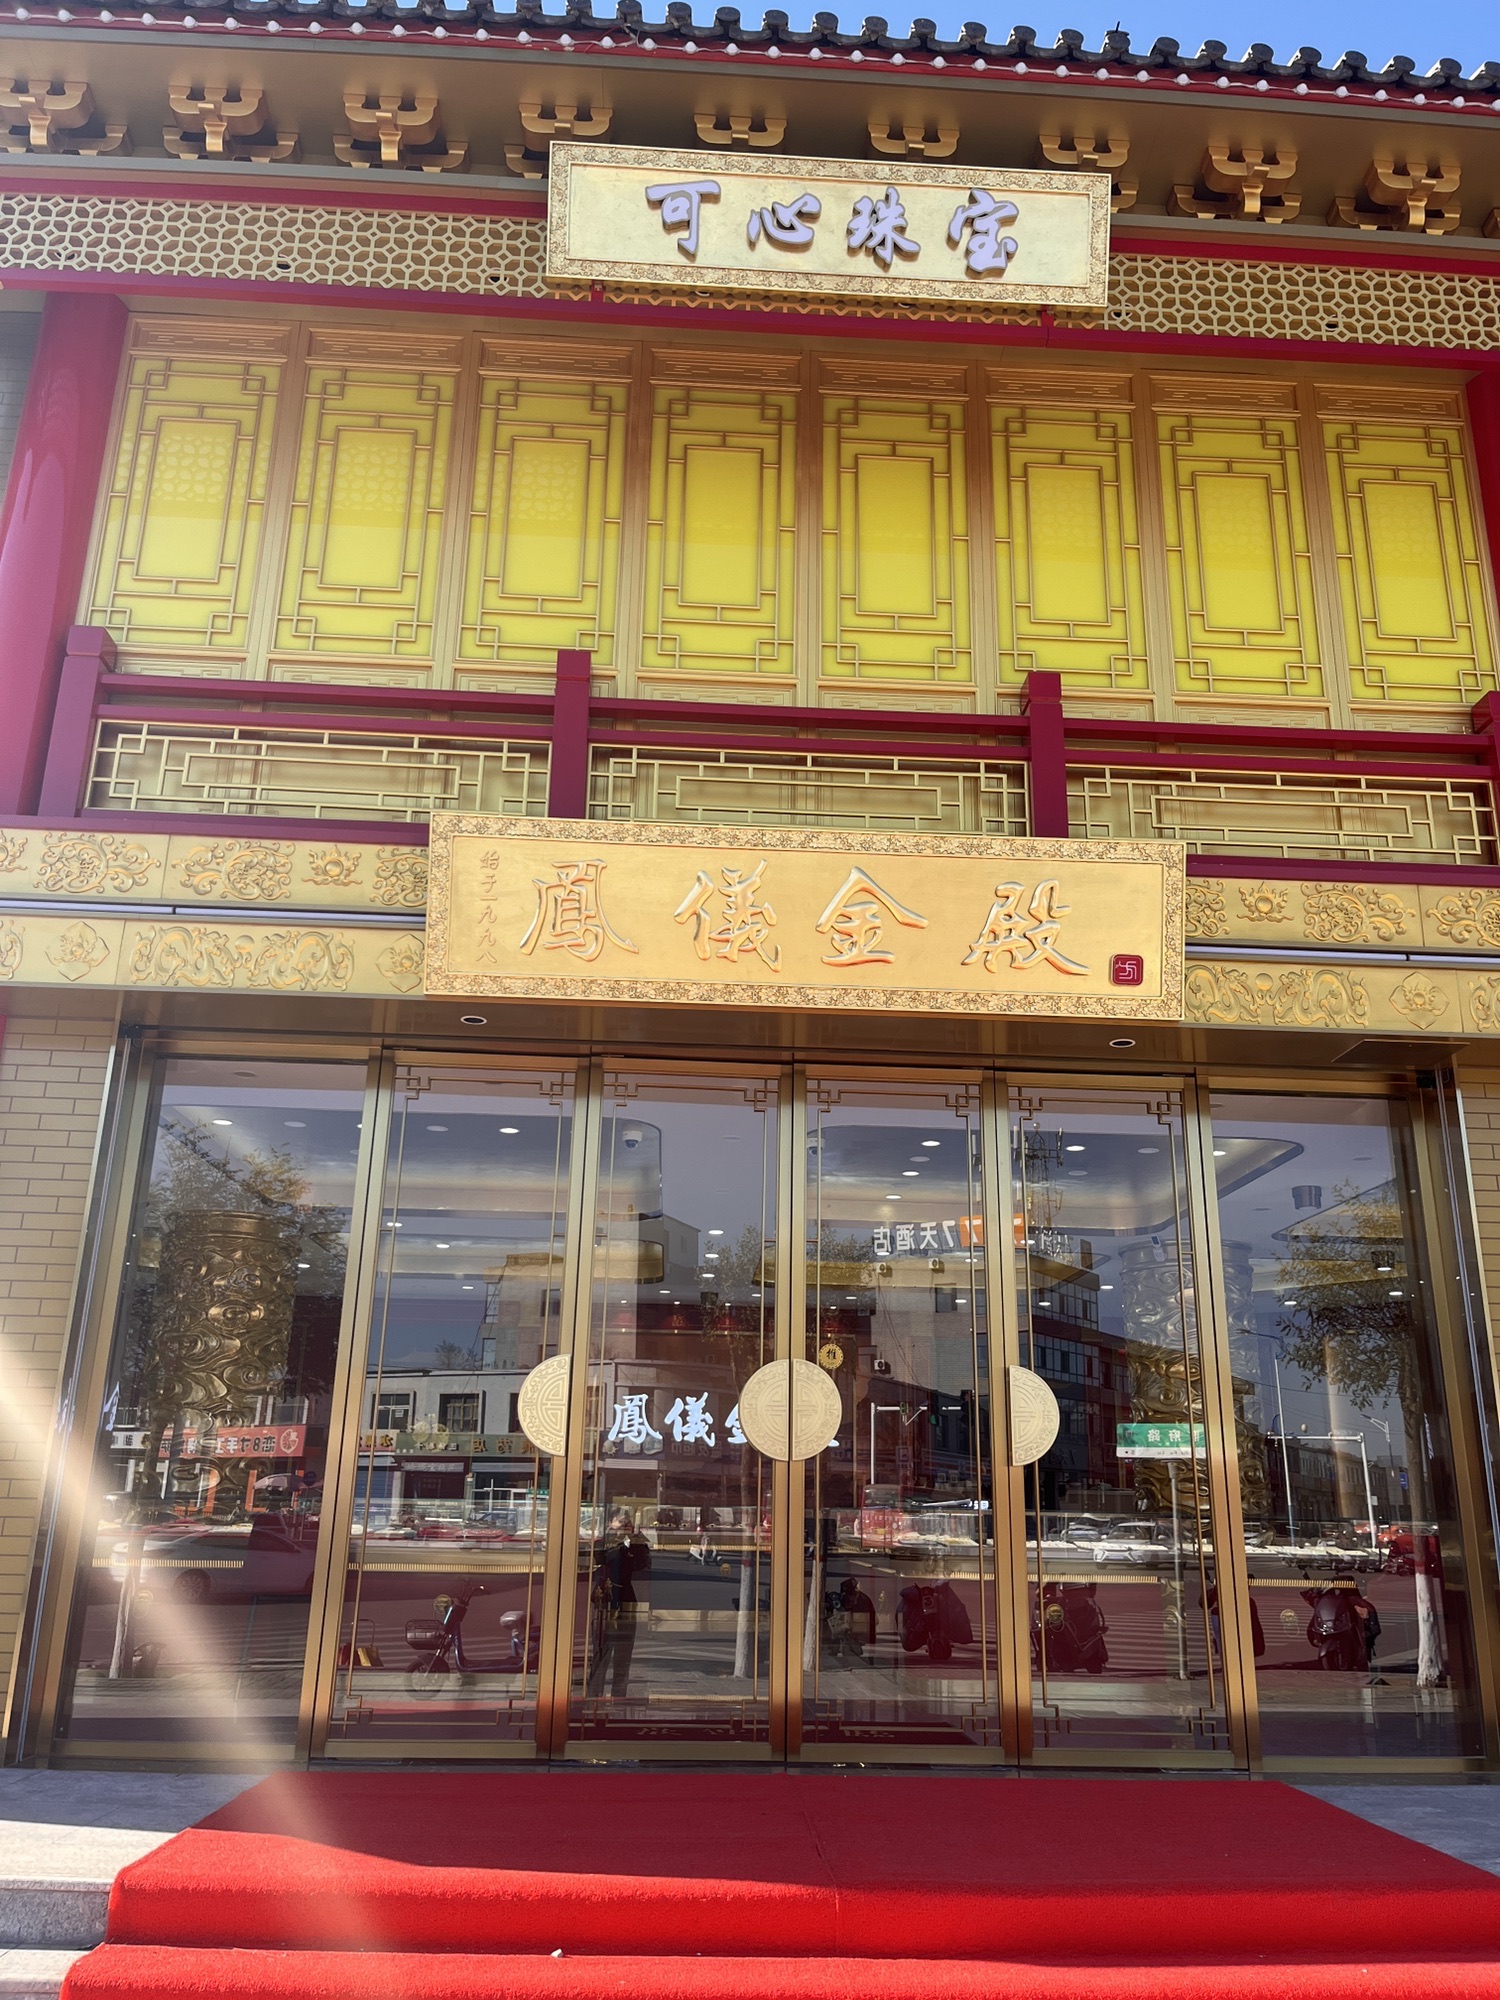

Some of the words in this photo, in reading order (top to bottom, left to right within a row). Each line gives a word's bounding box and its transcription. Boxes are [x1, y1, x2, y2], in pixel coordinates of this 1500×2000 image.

[644, 179, 1019, 276] 可心珠宝
[477, 850, 500, 964] 始于一九九八
[519, 858, 1092, 976] 鳳儀金殿
